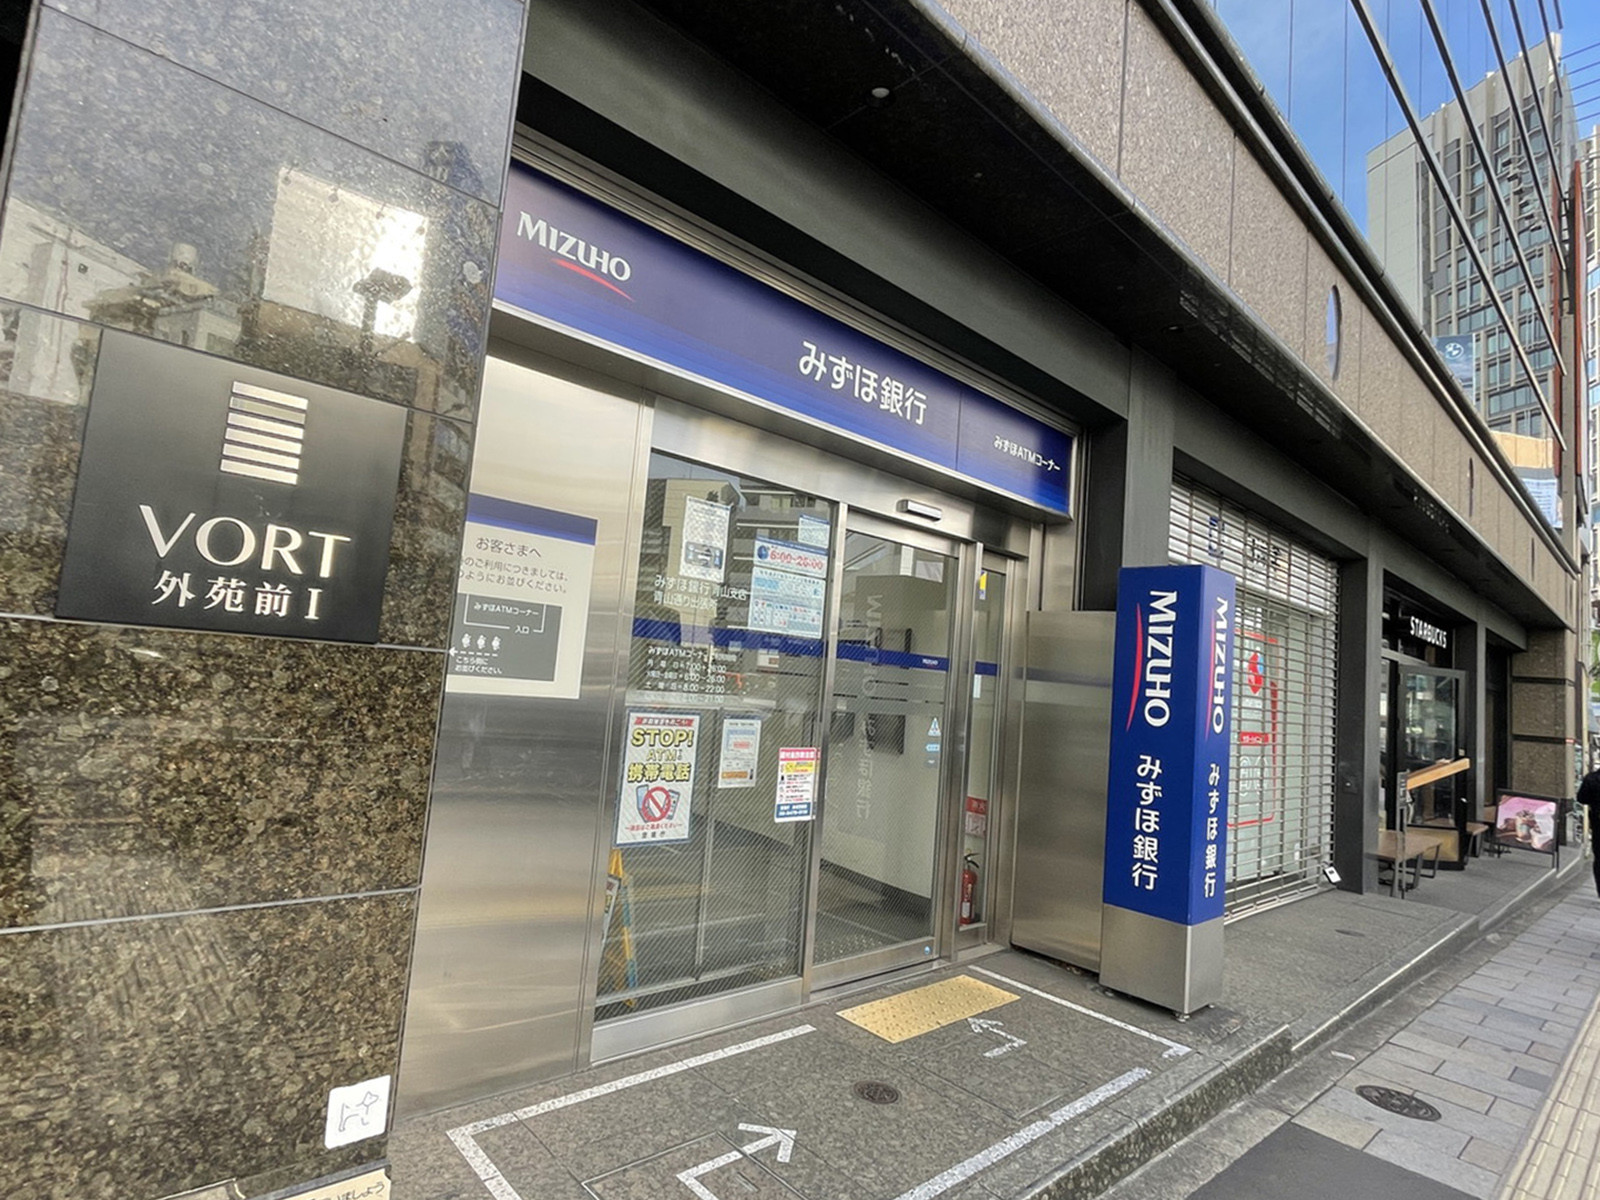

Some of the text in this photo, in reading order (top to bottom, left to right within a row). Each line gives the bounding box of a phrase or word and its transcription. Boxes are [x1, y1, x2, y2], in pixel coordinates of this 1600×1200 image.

[516, 211, 632, 283] MIZUHO
[797, 340, 927, 425] みずほ銀行
[993, 435, 1060, 472] みずほATMコーナー
[139, 504, 352, 579] VORT
[475, 536, 542, 558] お客さまへ
[514, 625, 530, 635] 入口
[1410, 615, 1448, 649] STARBUCKS
[1143, 590, 1178, 728] MIZUHO
[1211, 596, 1229, 735] MIZUHO
[631, 728, 694, 748] STOP!
[646, 748, 678, 762] ATM
[627, 763, 691, 782] 携帯電話
[1131, 754, 1163, 891] みずほ銀行
[1203, 762, 1221, 898] みずほ銀行
